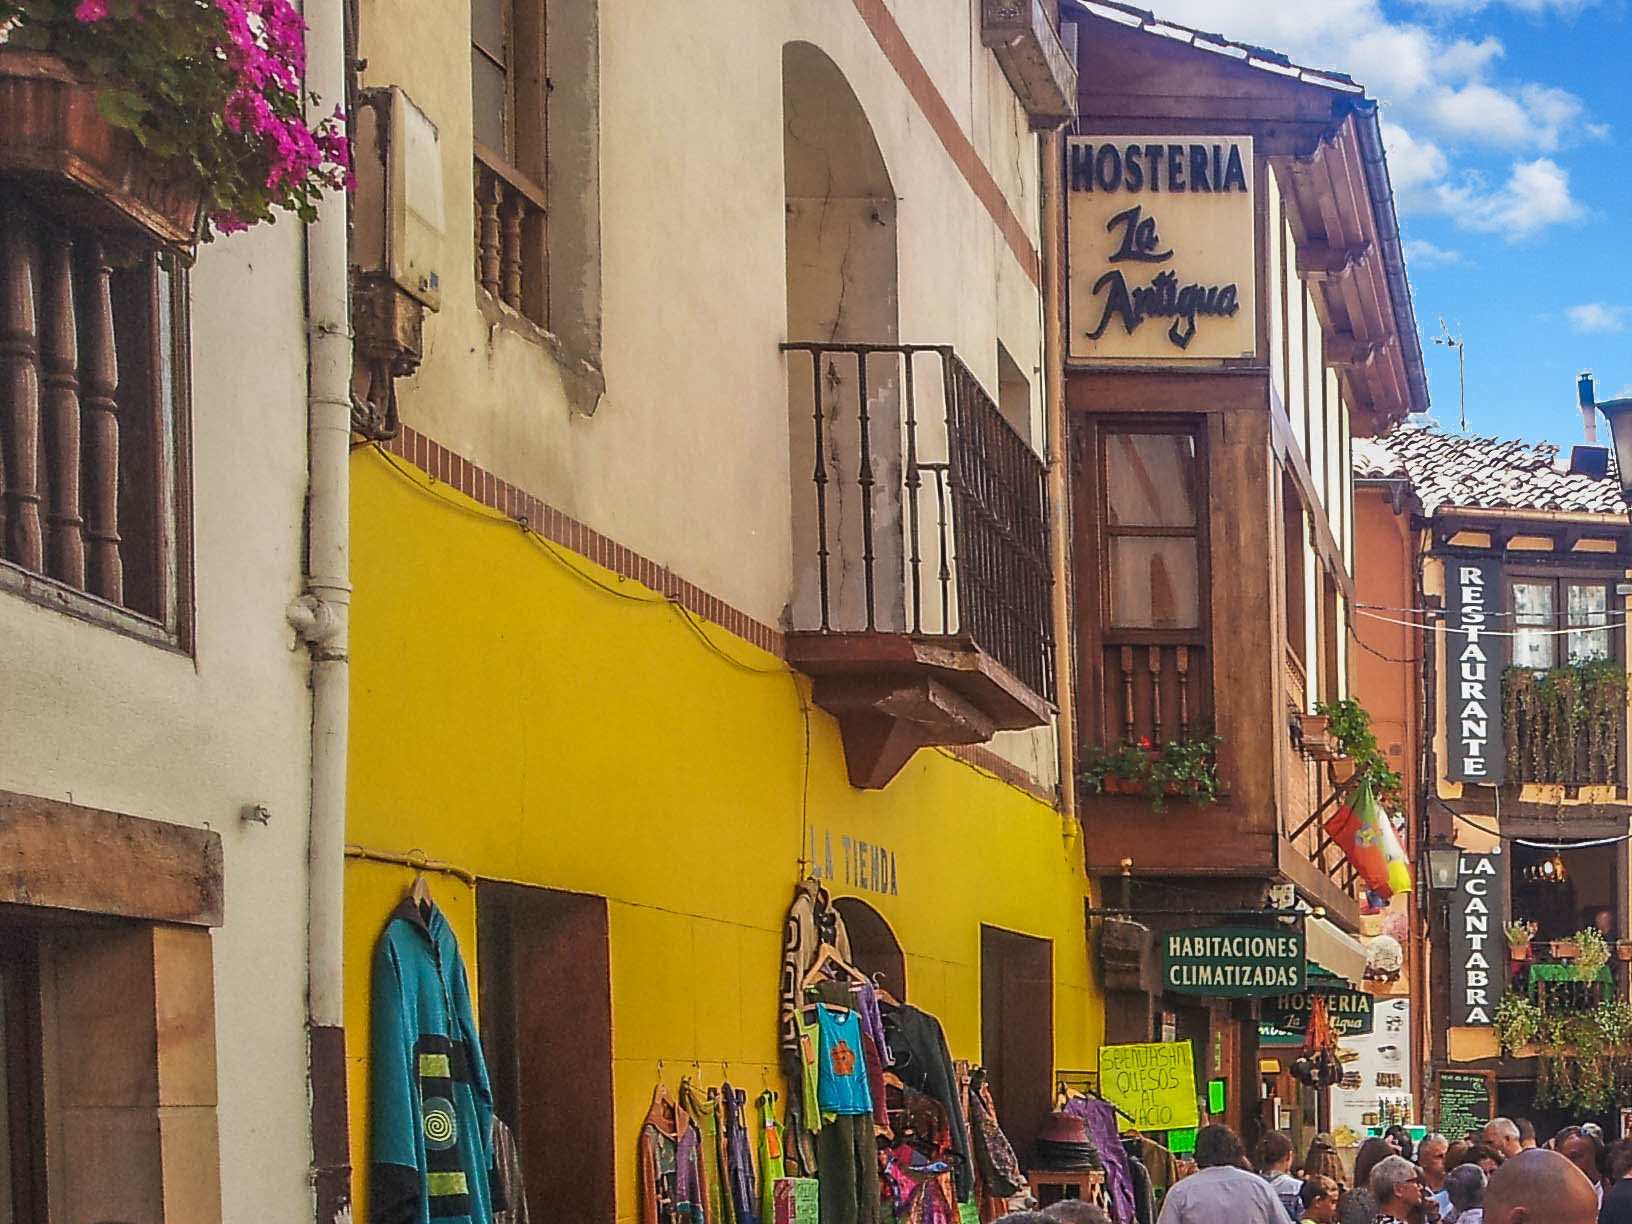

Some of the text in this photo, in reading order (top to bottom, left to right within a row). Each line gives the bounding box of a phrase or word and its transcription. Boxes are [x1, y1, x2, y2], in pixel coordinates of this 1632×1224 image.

[1071, 143, 1248, 193] HOSTERIA
[1106, 204, 1174, 262] La
[1086, 269, 1239, 349] Antigua
[1458, 567, 1488, 776] RESTAURANTE
[1459, 857, 1496, 876] LA
[1169, 936, 1298, 957] HABITACIONES
[1464, 878, 1490, 1024] CANTABRA
[1169, 965, 1298, 986] CLIMATIZADAS
